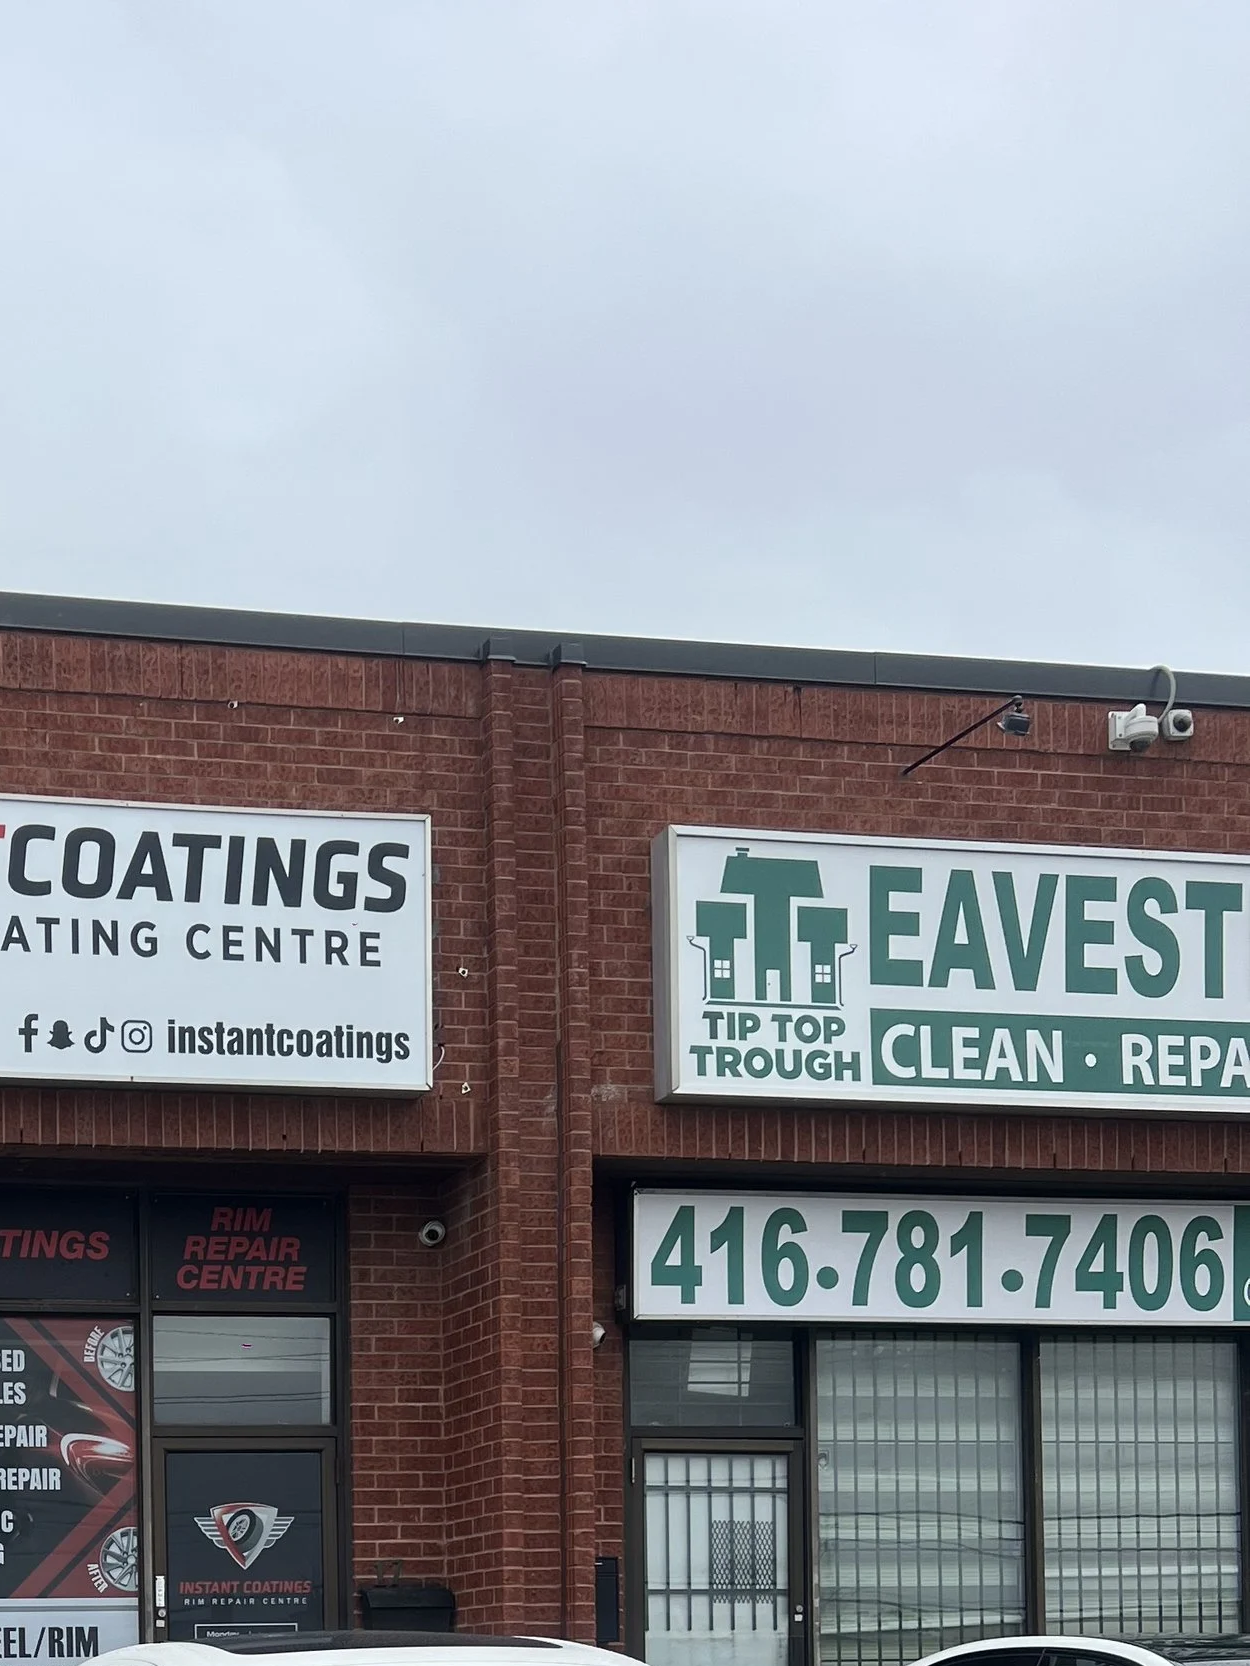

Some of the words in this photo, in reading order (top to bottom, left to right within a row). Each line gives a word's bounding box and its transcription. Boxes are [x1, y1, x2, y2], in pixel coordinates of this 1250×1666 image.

[185, 922, 381, 967] CENTRE
[869, 864, 1243, 999] EAVEST
[167, 1018, 410, 1064] instantcoatings
[701, 1011, 762, 1041] TIP
[770, 1013, 846, 1044] TOP
[688, 1044, 862, 1082] TROUGH
[880, 1023, 1064, 1083] CLEAN
[210, 1207, 273, 1233] RIM
[183, 1235, 301, 1262] REPAIR
[175, 1264, 307, 1291] CENTRE
[87, 1563, 108, 1593] AFTER
[179, 1581, 240, 1594] INSTANT
[243, 1580, 312, 1593] COATINGS
[184, 1598, 205, 1606] RIM
[262, 1597, 307, 1605] CENTRE
